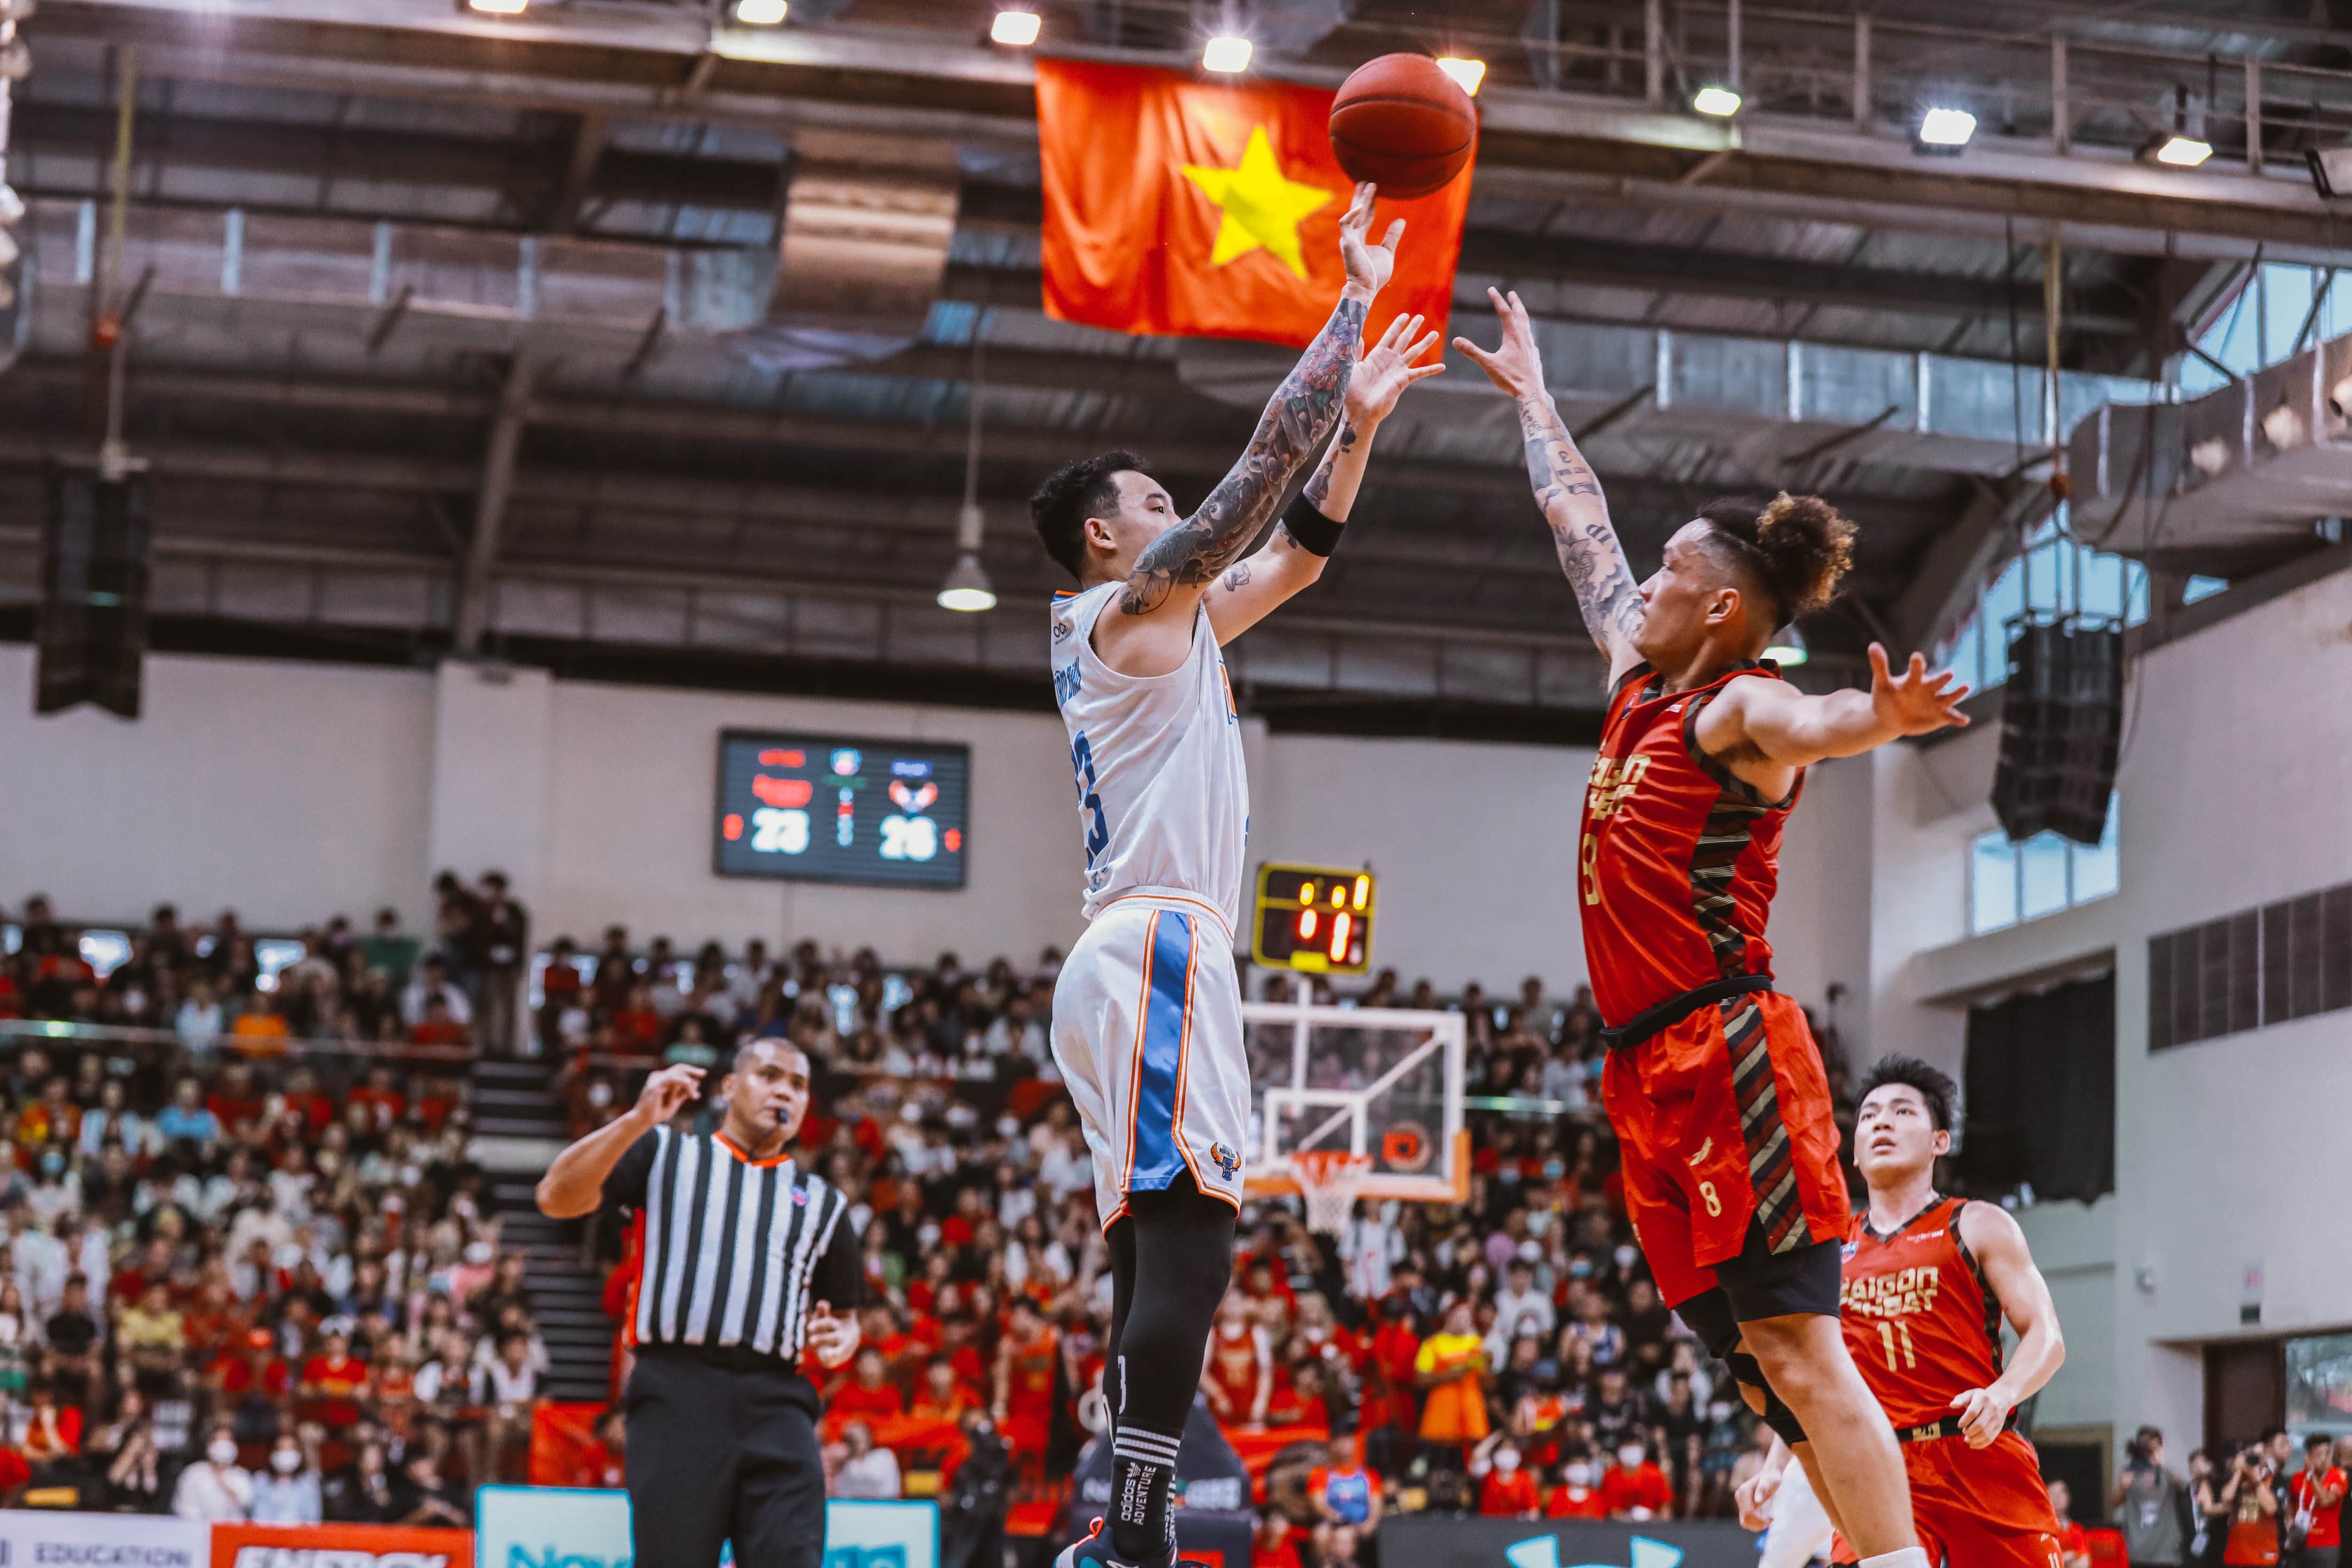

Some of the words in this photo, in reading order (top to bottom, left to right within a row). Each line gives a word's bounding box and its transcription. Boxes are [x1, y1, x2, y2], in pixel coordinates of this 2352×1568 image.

[1699, 1181, 1722, 1218] 8
[1876, 1321, 1916, 1371] 11
[1120, 1478, 1136, 1521] adidas
[1133, 1465, 1157, 1526] ADVENTURE
